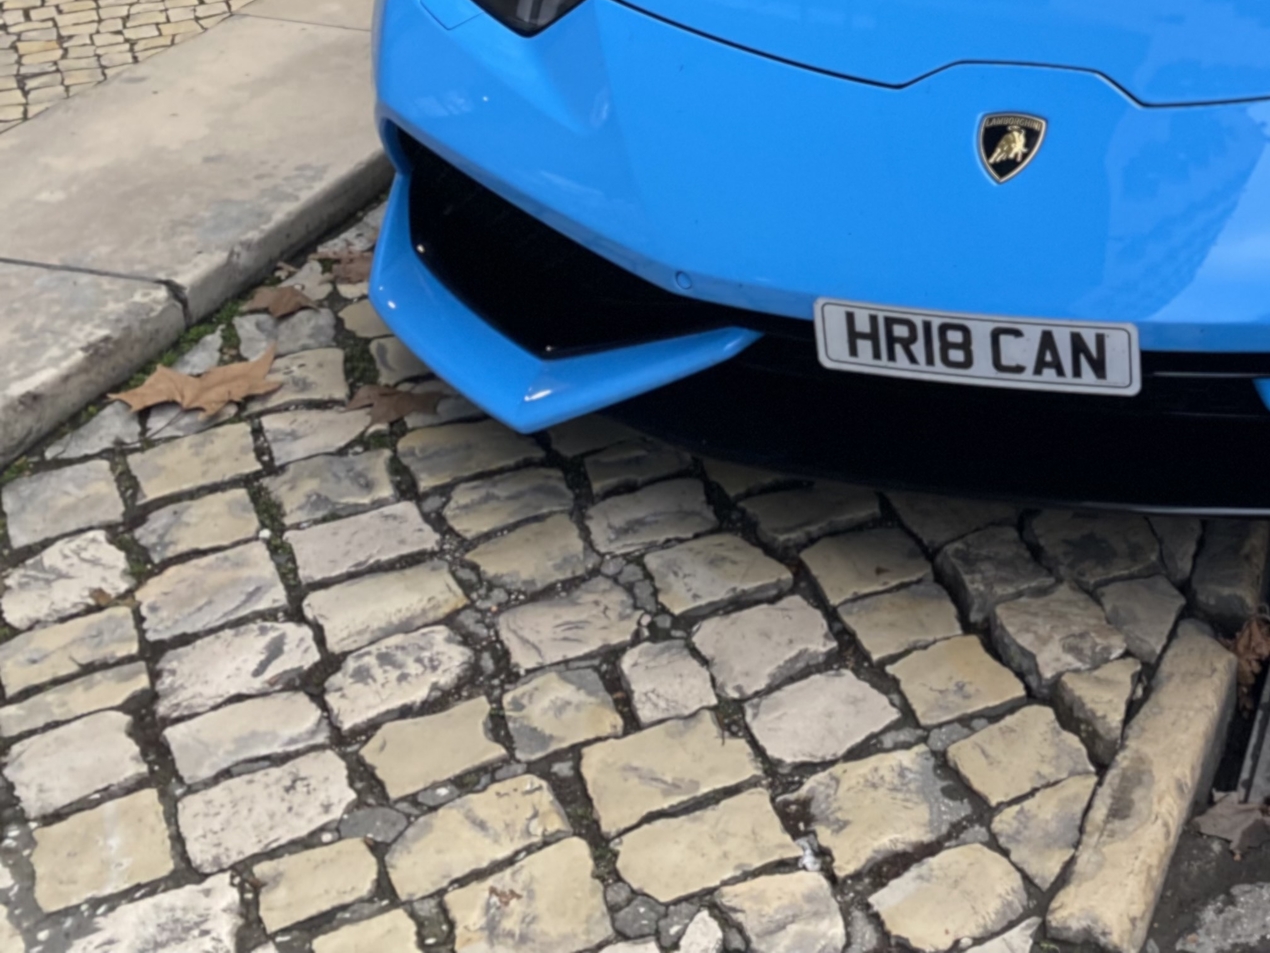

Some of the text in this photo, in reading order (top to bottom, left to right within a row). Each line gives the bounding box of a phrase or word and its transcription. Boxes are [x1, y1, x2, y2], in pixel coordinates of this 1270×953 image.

[985, 117, 1042, 131] LAMBORGHINI
[845, 311, 1107, 380] HR18 CAN
